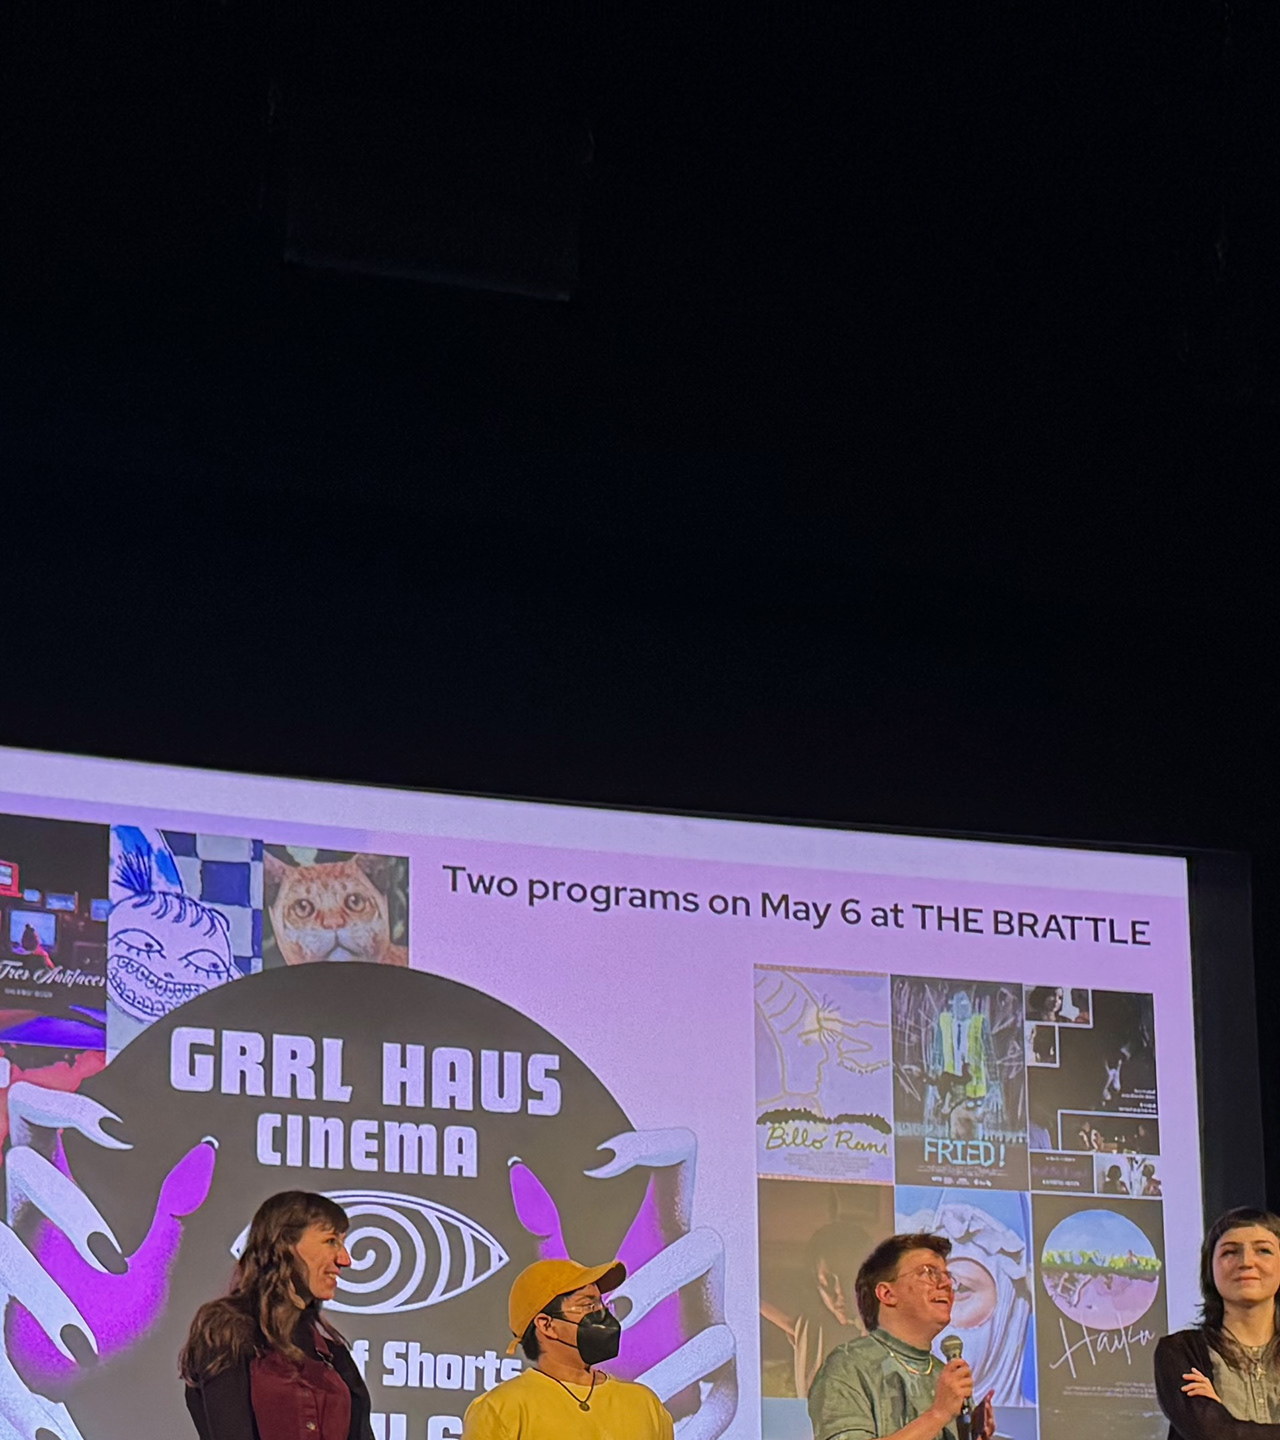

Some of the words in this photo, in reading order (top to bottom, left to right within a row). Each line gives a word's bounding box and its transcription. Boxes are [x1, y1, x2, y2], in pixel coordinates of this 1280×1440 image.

[442, 864, 519, 898] Two
[527, 877, 700, 913] programs
[708, 894, 751, 917] on
[761, 892, 833, 930] May
[840, 898, 862, 925] 6
[871, 903, 905, 929] at
[912, 904, 984, 935] THE
[992, 909, 1152, 946] BRATTLE
[169, 1025, 354, 1103] GRRL
[381, 1040, 562, 1117] HAUS
[256, 1111, 479, 1178] CINEMA
[382, 1340, 523, 1392] Shorts
